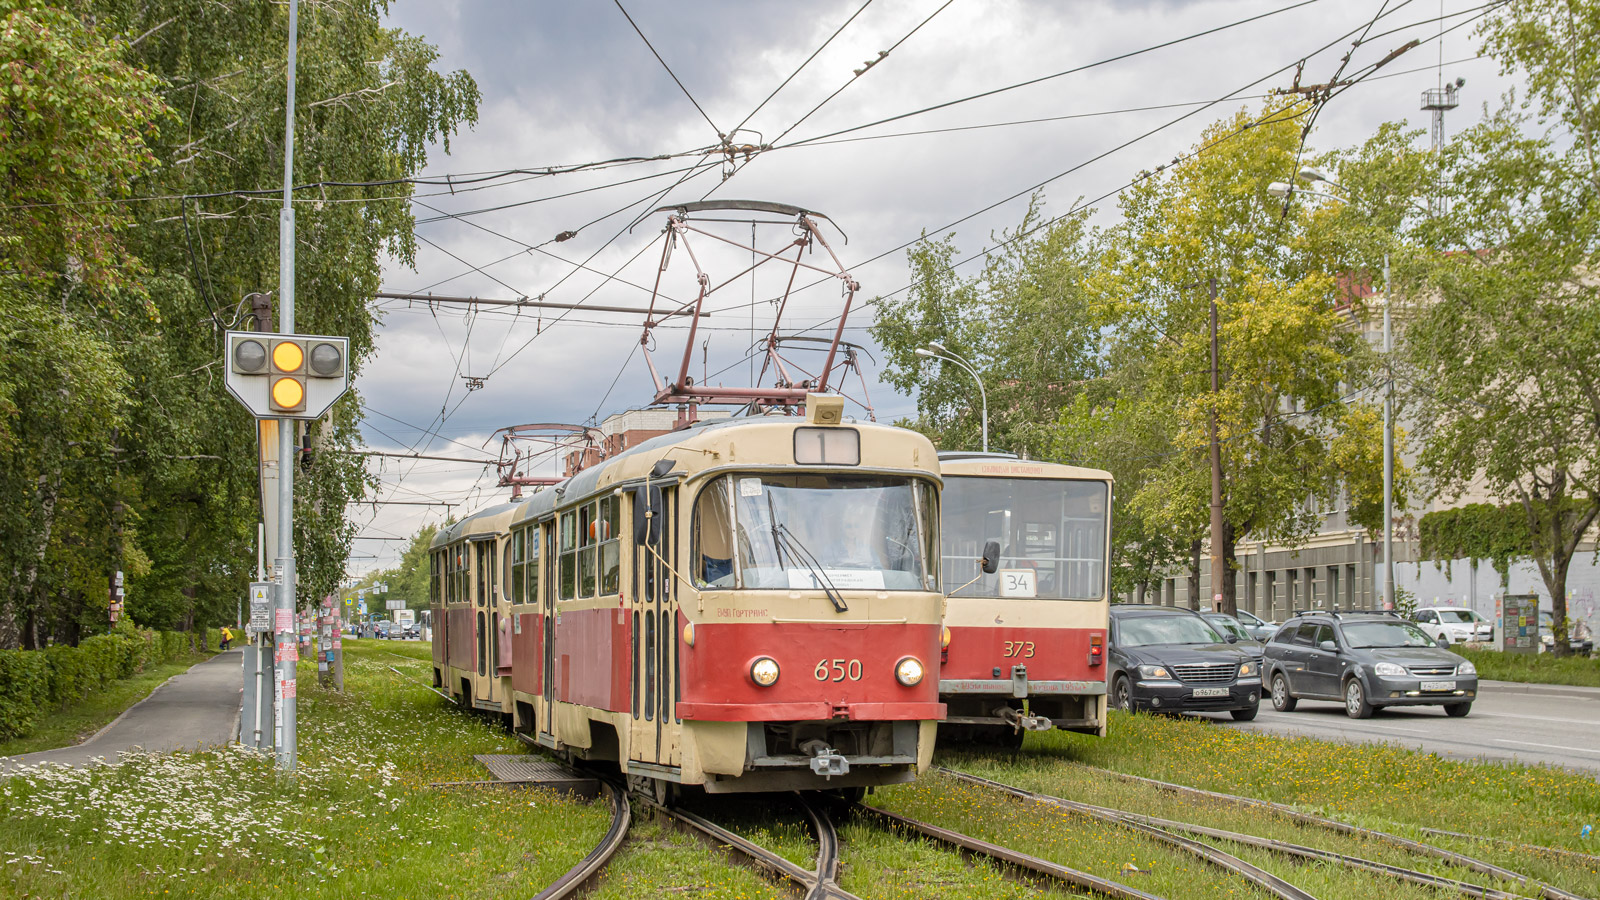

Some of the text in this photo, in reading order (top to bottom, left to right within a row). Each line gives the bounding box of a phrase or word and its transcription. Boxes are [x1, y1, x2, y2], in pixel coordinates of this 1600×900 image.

[817, 432, 826, 463] 1
[1006, 574, 1028, 591] 34
[1003, 640, 1036, 658] 373
[814, 658, 864, 682] 650
